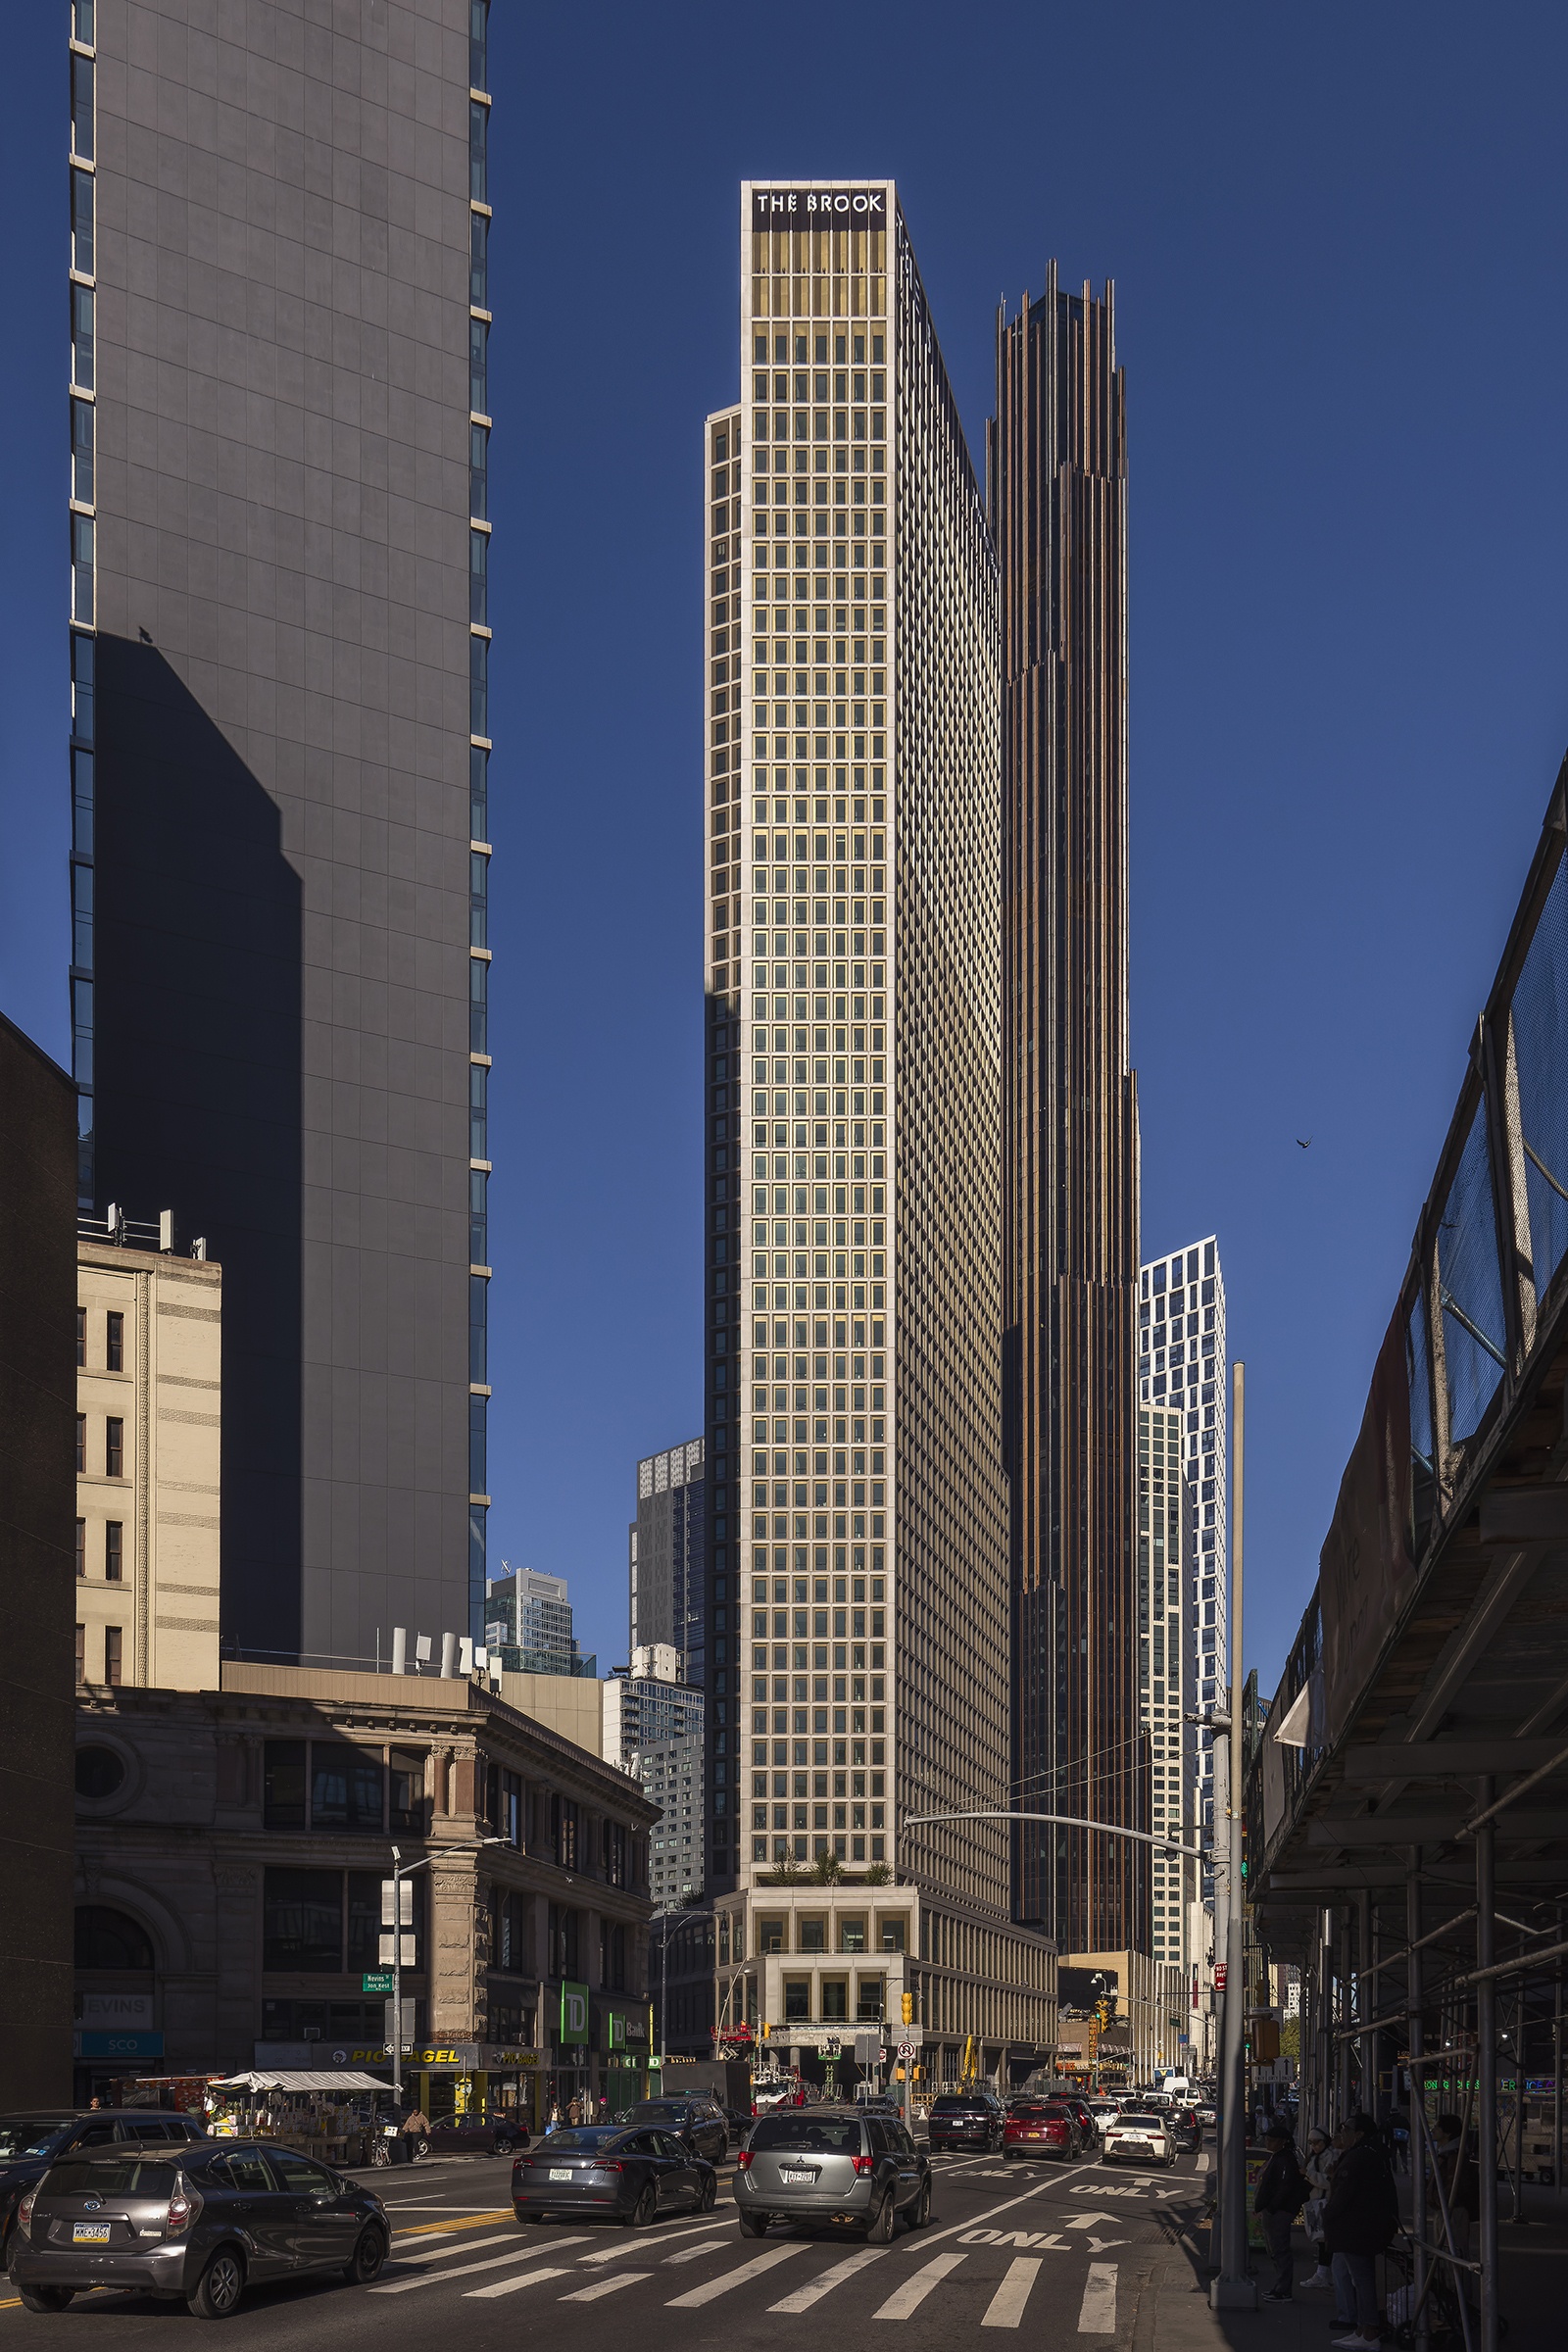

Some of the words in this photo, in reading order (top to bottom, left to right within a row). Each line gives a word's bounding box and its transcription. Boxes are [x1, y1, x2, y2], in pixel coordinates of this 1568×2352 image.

[758, 195, 797, 212] THE
[808, 194, 884, 213] BROOK
[565, 1992, 586, 2032] TD
[613, 2020, 623, 2041] TD
[626, 2022, 646, 2037] Bank
[108, 2039, 138, 2050] SCO
[351, 2050, 385, 2063] PIO
[948, 2170, 1054, 2180] ONLY
[1069, 2184, 1184, 2199] ONLY
[956, 2229, 1132, 2253] ONLY
